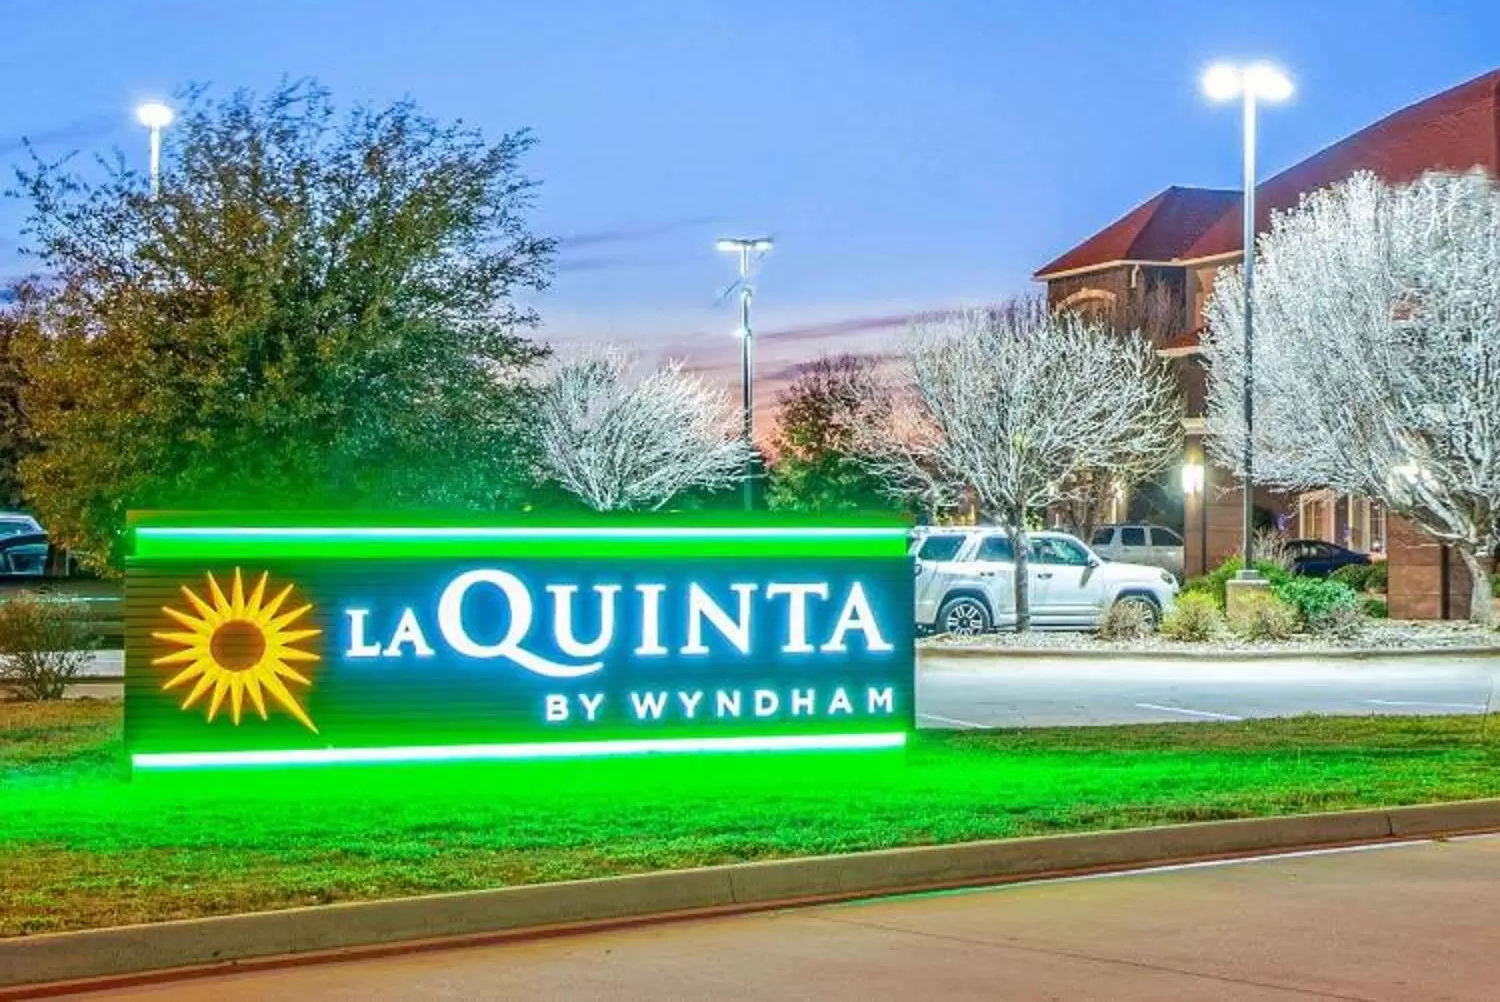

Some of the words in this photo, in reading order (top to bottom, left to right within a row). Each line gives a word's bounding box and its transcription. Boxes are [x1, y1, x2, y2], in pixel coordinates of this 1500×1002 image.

[438, 570, 892, 677] QUINTA
[546, 693, 603, 721] BY
[632, 688, 893, 719] WYNDHAM
